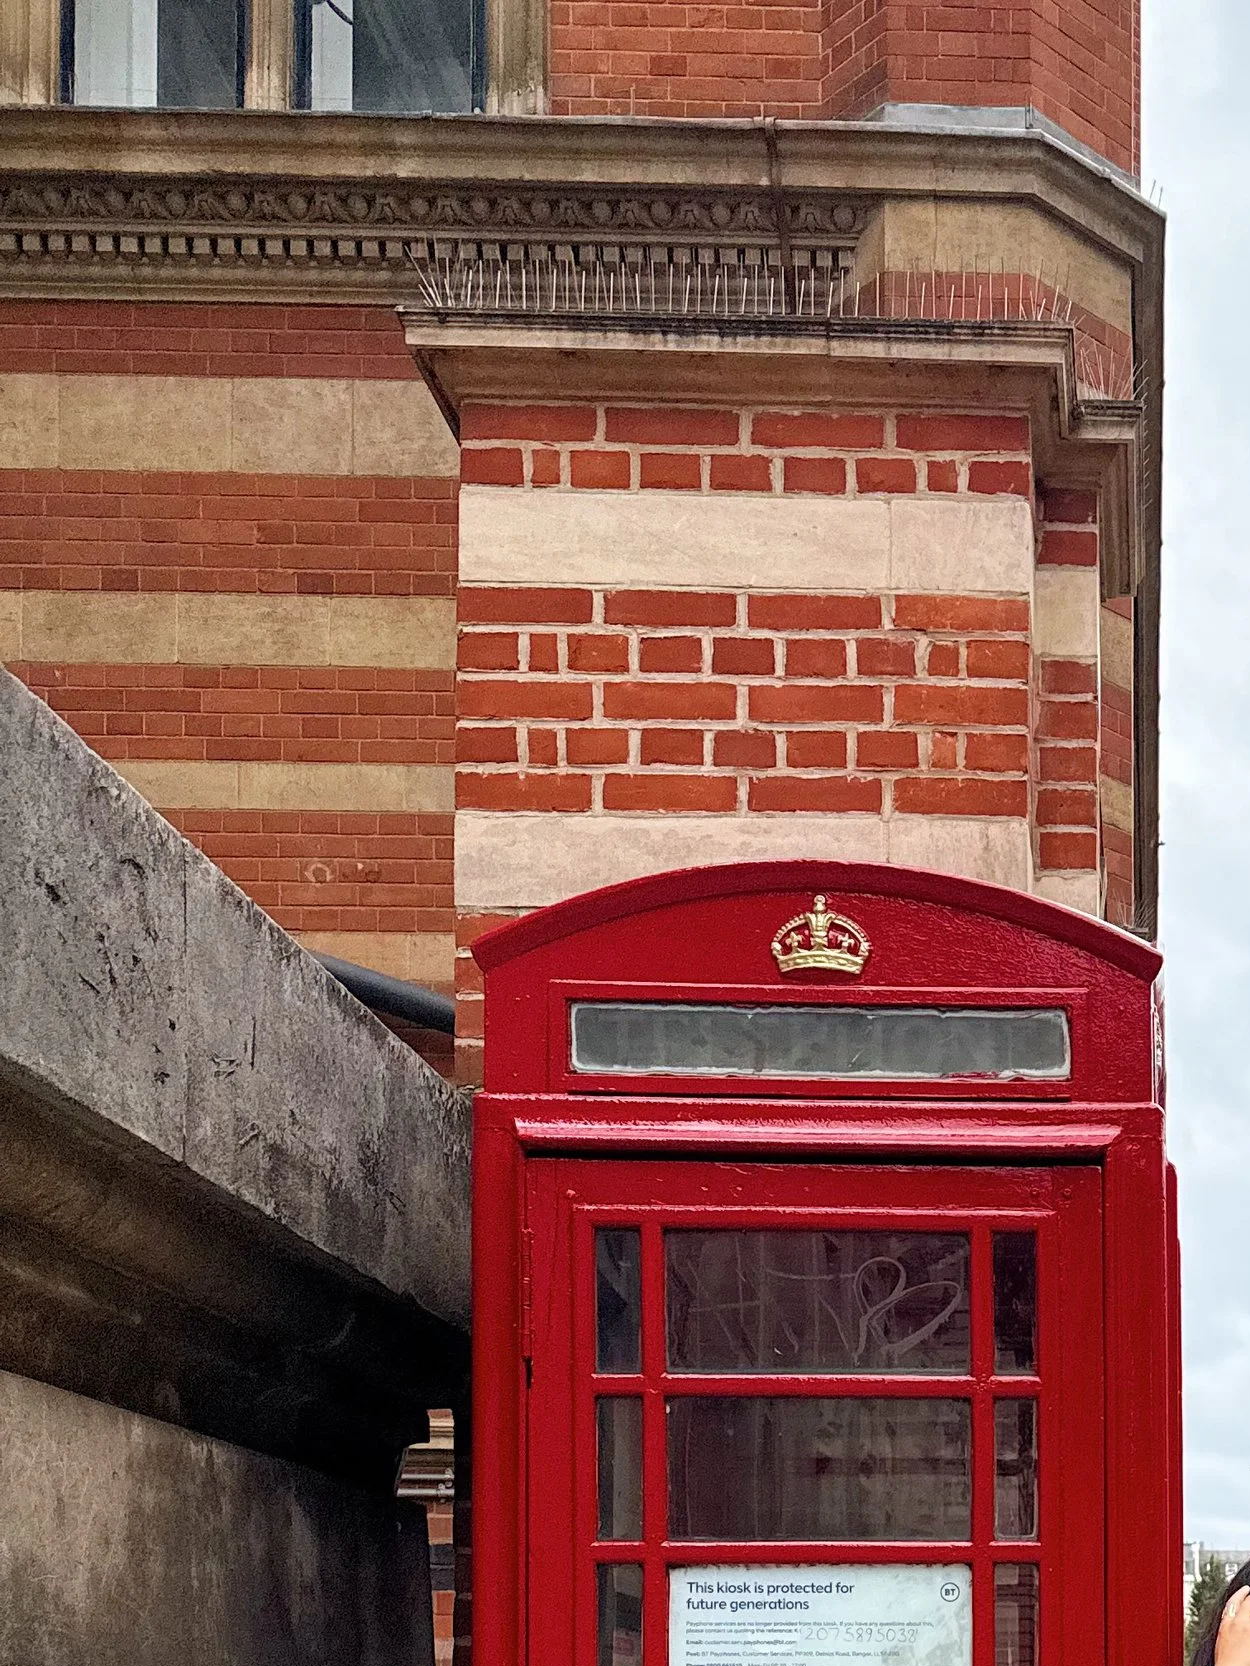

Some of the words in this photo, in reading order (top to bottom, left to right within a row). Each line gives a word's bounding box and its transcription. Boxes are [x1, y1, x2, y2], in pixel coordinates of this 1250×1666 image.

[687, 1582, 714, 1593] This
[717, 1582, 751, 1594] kiosk
[754, 1582, 764, 1594] is
[767, 1582, 833, 1596] protected
[836, 1582, 855, 1594] for
[944, 1588, 956, 1596] BT
[687, 1598, 727, 1610] future
[730, 1599, 810, 1613] generations
